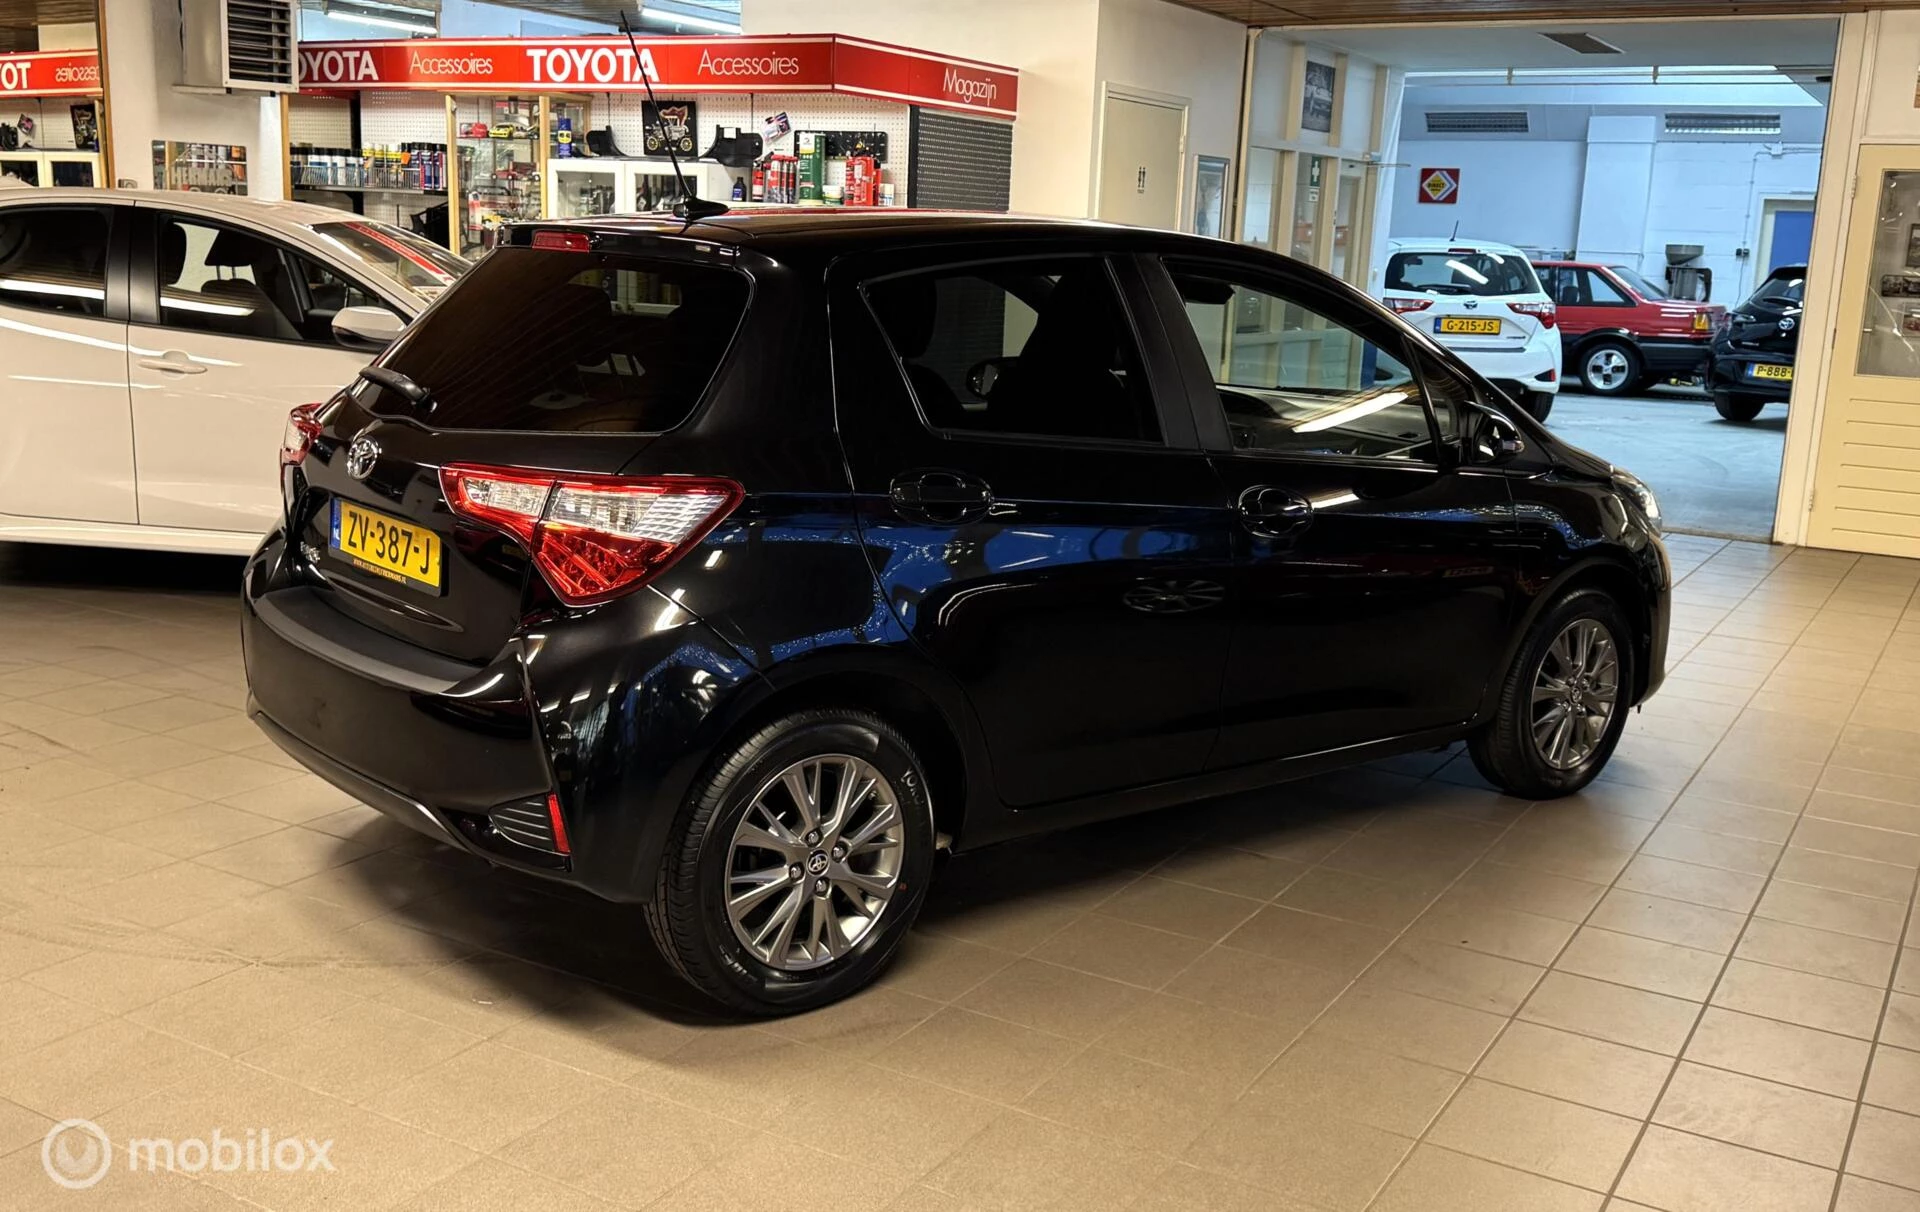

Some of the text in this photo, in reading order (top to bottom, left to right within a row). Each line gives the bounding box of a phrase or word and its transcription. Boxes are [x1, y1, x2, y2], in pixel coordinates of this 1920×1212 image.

[409, 51, 493, 75] Accessoires
[526, 48, 660, 82] TOYOTA
[697, 48, 800, 76] Accessoires
[942, 67, 997, 107] Magazijn
[1446, 320, 1494, 332] G-215-JS
[1756, 365, 1793, 378] P-888-
[347, 510, 431, 575] ZV-387-J
